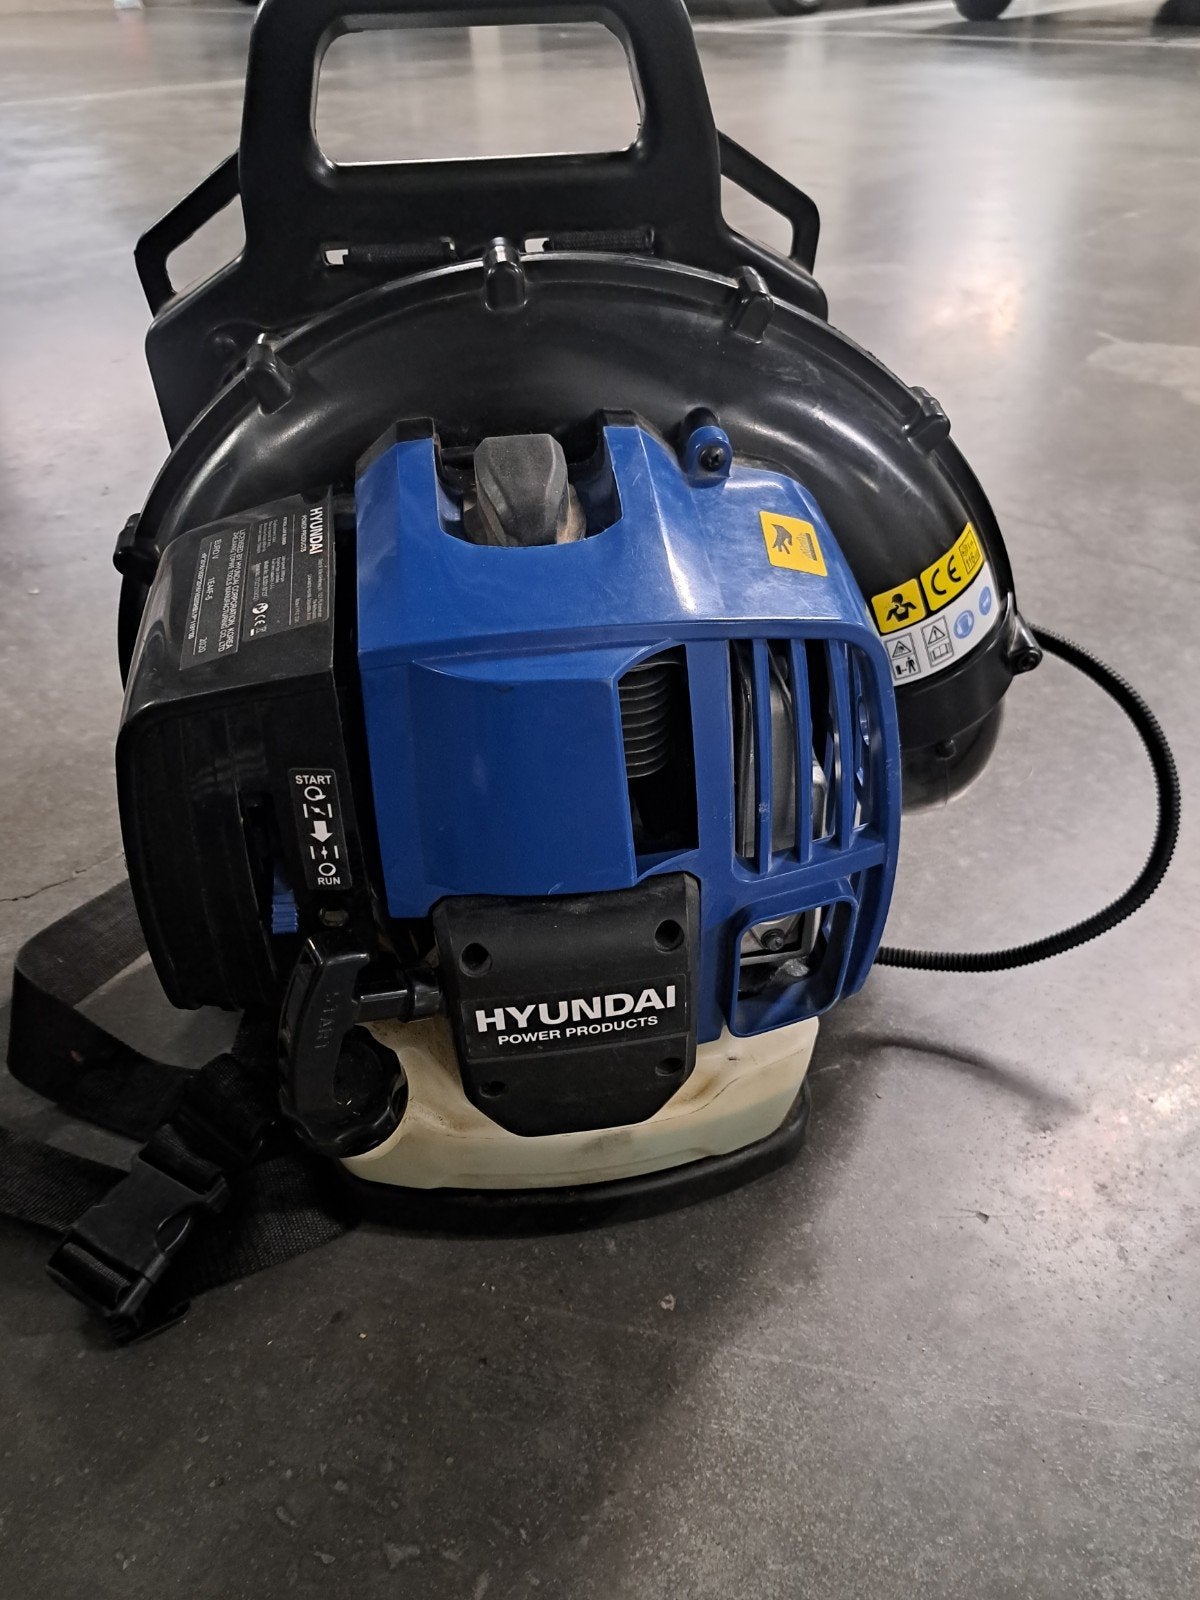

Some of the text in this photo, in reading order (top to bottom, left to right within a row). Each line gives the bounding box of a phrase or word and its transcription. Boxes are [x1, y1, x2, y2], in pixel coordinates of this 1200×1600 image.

[309, 507, 322, 554] HYUNDAI
[213, 539, 221, 554] EURO
[232, 560, 242, 585] HYUNDAI
[198, 637, 207, 652] 2020
[224, 626, 234, 649] KOREA
[295, 775, 332, 785] START
[318, 877, 341, 885] RUN
[475, 985, 676, 1032] HYUNDAI
[498, 1015, 658, 1045] POWER PRODUCTS
